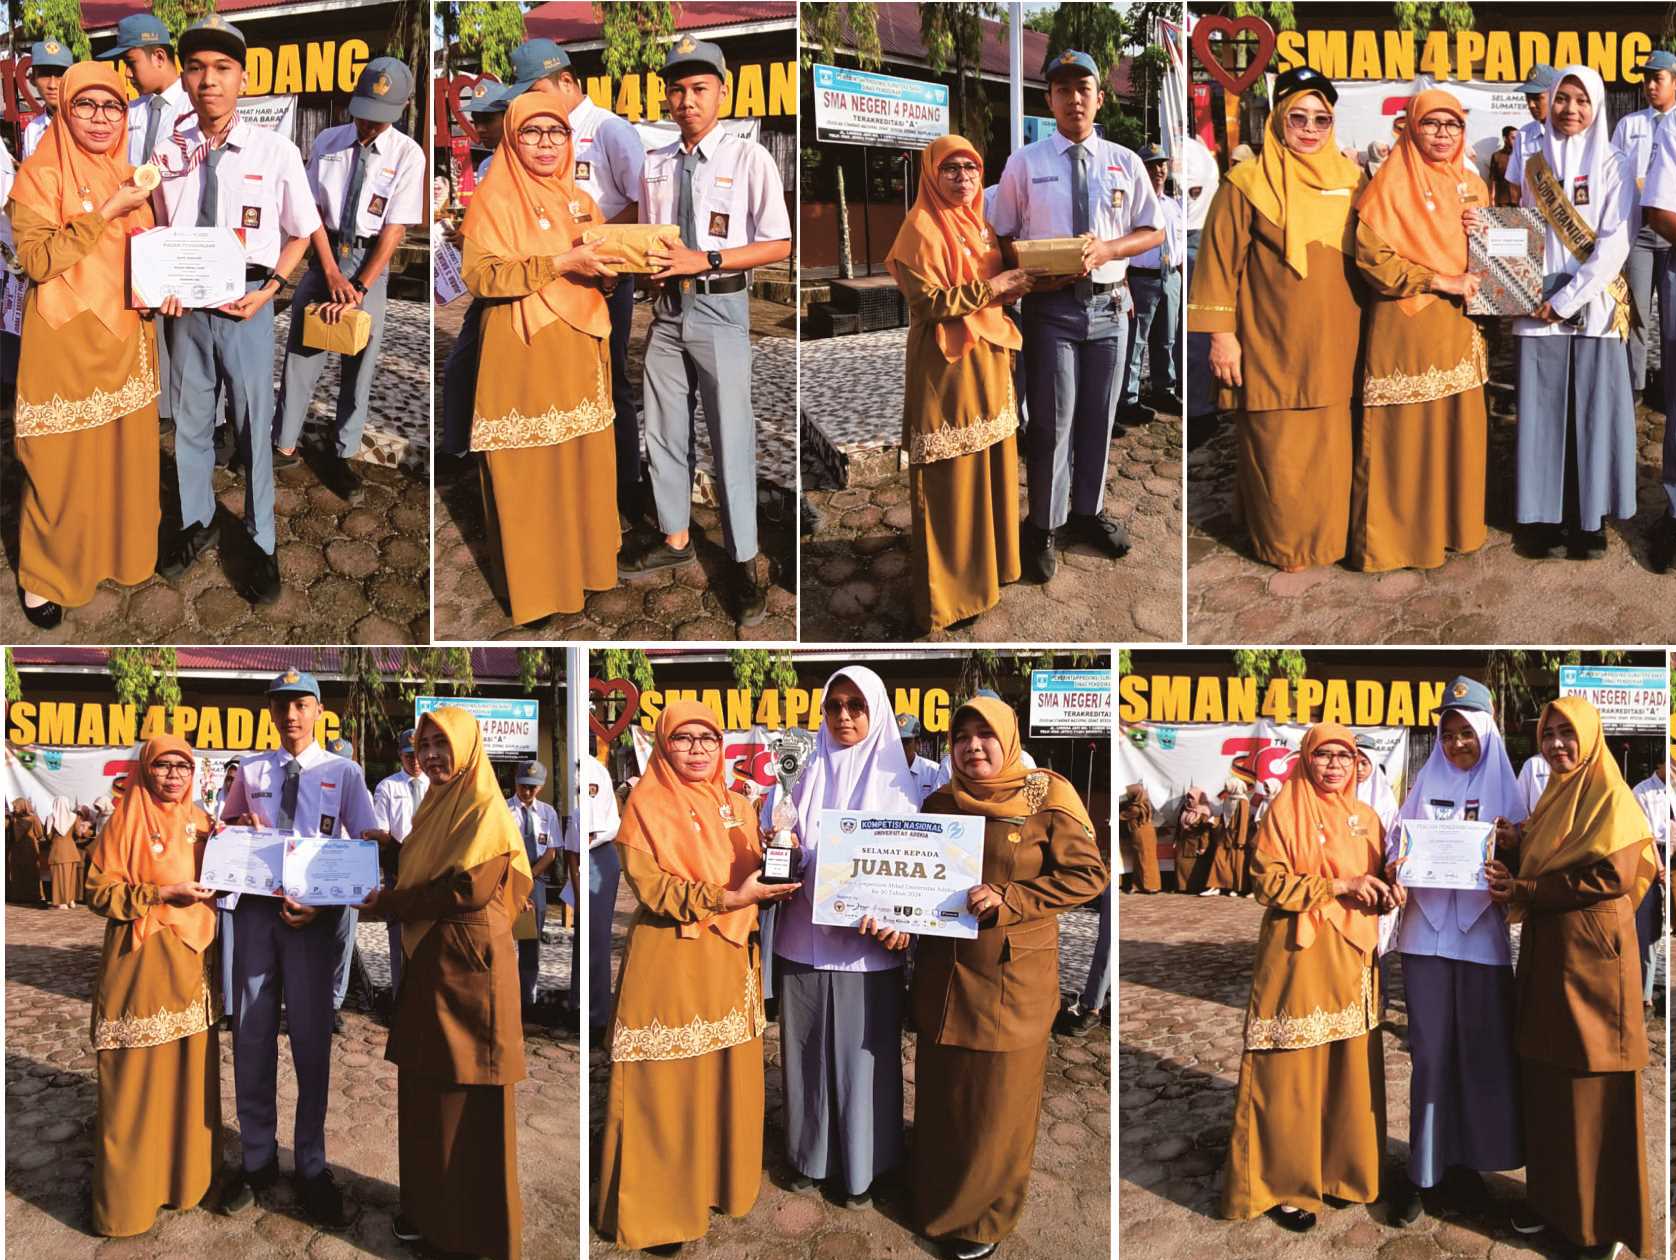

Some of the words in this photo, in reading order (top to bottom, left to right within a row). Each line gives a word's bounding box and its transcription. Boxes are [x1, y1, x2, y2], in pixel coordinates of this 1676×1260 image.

[1490, 102, 1527, 110] SUMATER
[1491, 94, 1525, 102] SELAMA
[823, 91, 847, 112] SMA
[852, 96, 891, 118] NEGERI
[894, 102, 900, 118] 4
[902, 104, 941, 123] PADANG
[1038, 692, 1059, 708] SMA
[1063, 692, 1102, 708] NEGERI
[1592, 689, 1631, 705] NEGERI
[1634, 690, 1640, 704] 4
[491, 720, 530, 736] PADANG
[861, 819, 903, 831] KOMPETISI
[903, 820, 943, 833] NASIONAL
[861, 847, 902, 856] SELAMAT
[904, 849, 939, 858] KEPADA
[850, 858, 927, 880] JUARA
[933, 863, 947, 880] 2
